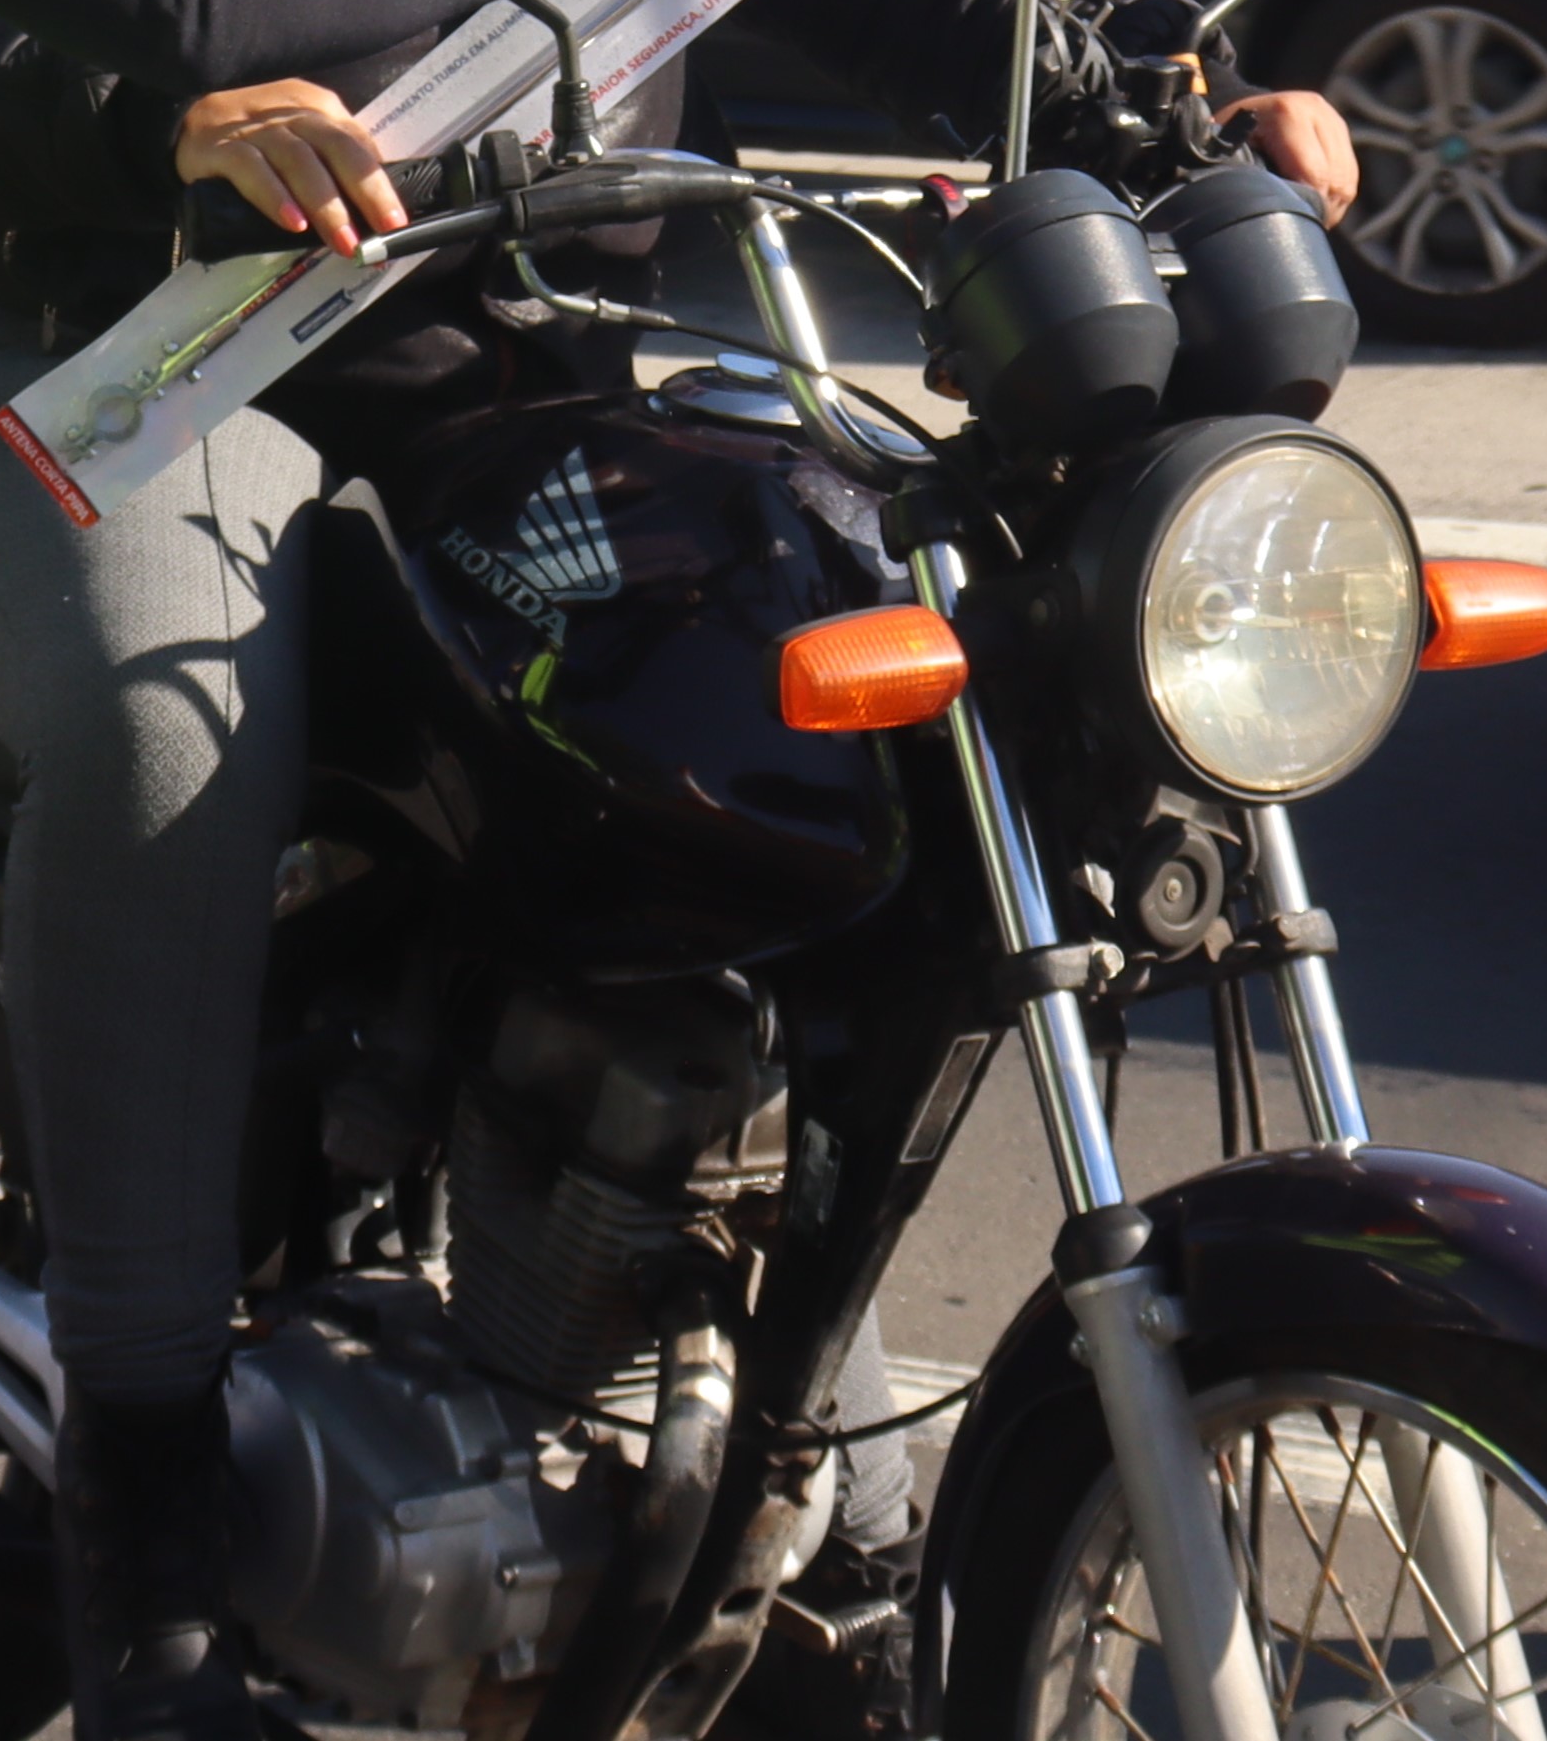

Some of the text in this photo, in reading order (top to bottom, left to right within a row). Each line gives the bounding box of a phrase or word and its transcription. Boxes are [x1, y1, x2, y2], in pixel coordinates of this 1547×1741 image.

[366, 79, 436, 137] MPRIMENTO
[432, 52, 470, 86] TUBOS
[485, 4, 528, 43] ALUMÍN
[625, 5, 706, 73] SEGURANÇA,
[62, 489, 92, 522] PIPA
[438, 525, 568, 647] HONDA
